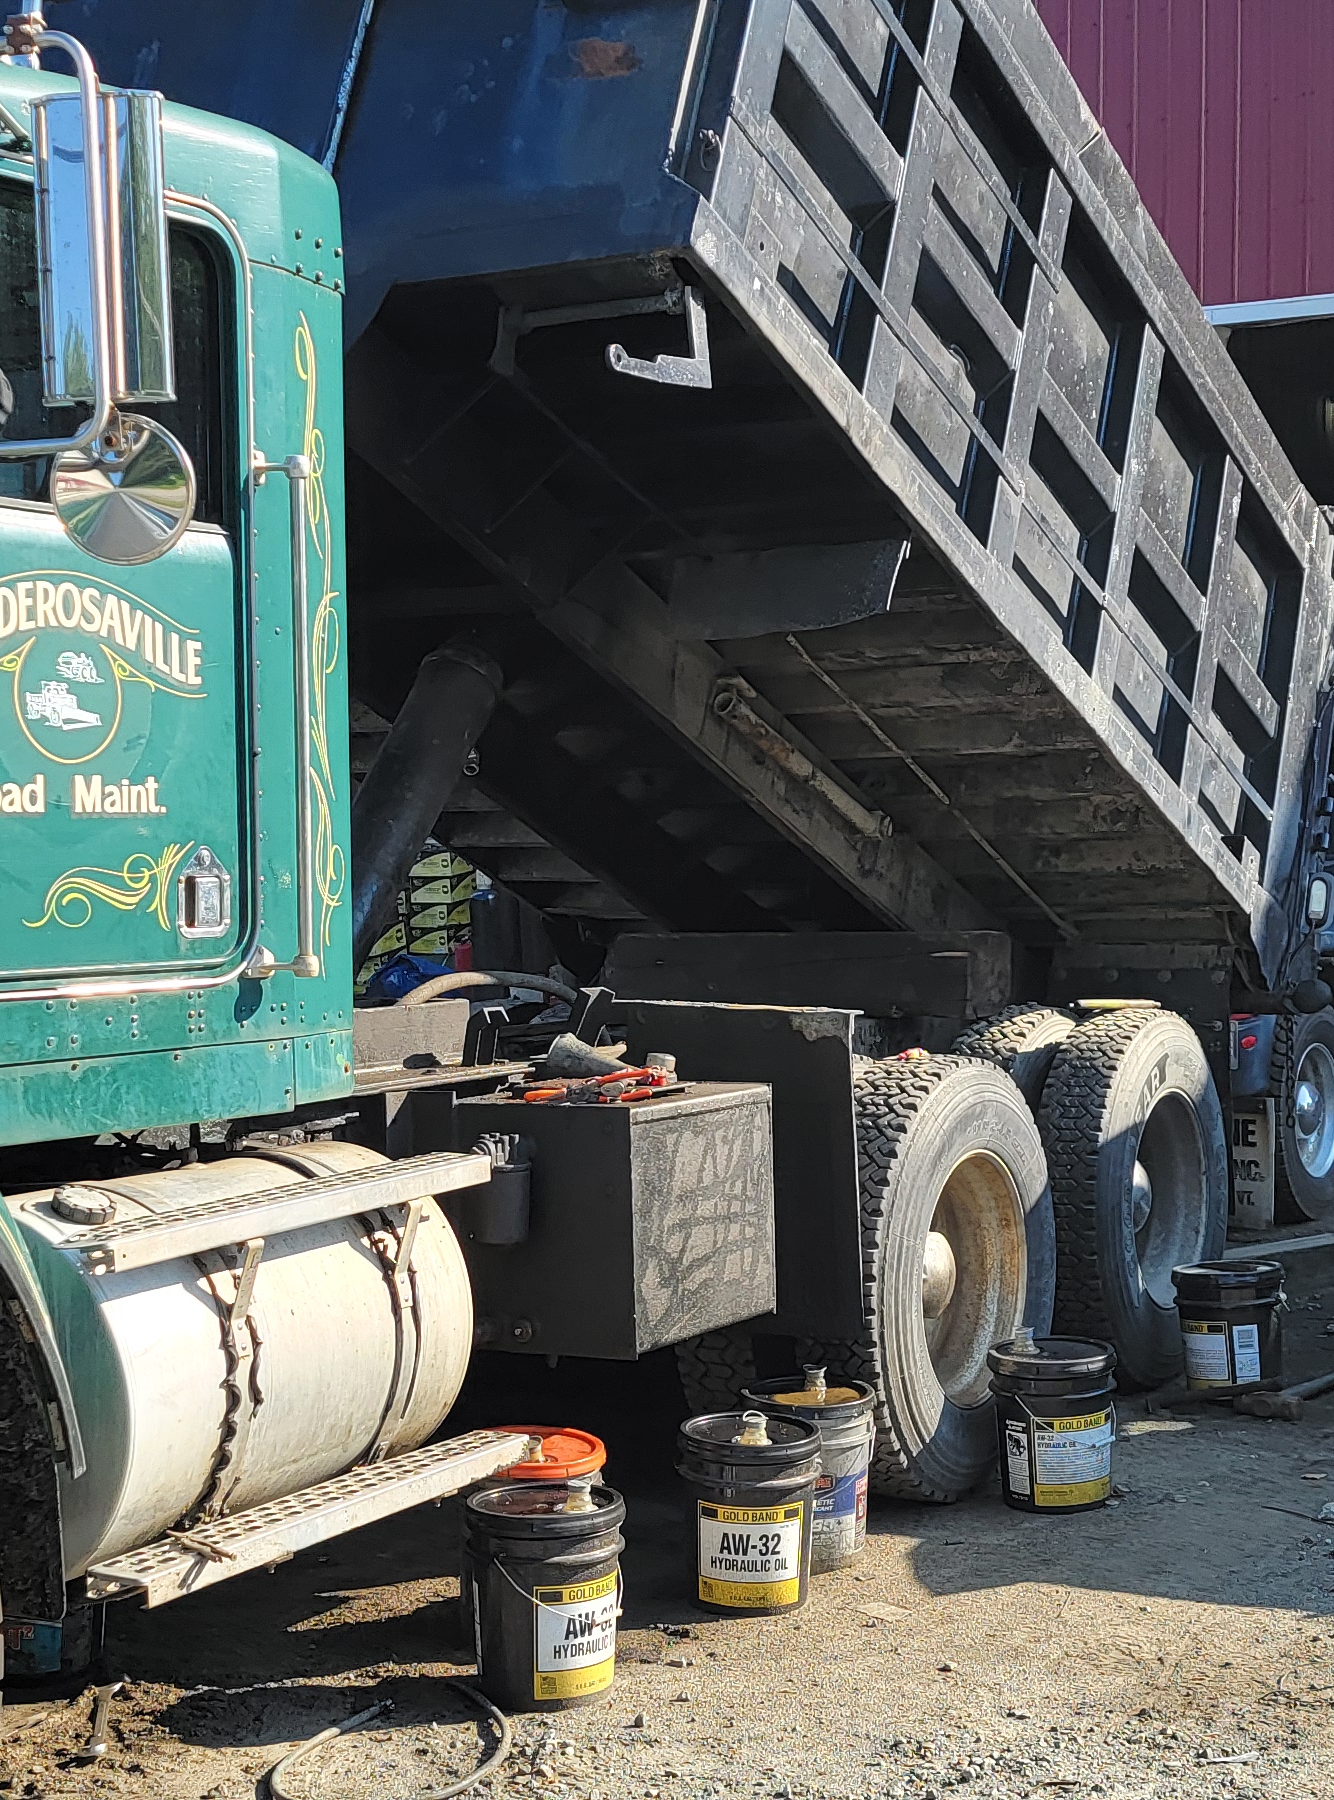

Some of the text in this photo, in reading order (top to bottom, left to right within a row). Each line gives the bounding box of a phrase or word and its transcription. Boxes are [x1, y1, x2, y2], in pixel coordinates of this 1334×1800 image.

[71, 773, 168, 817] Maint.
[1058, 1415, 1103, 1431] GOLD BAND
[723, 1511, 779, 1522] GOLD BAND
[719, 1532, 781, 1556] AW-32
[710, 1556, 788, 1572] HYDRAULIC OIL
[568, 1587, 594, 1601] GOLD
[553, 1636, 609, 1660] HYDRAULIC
